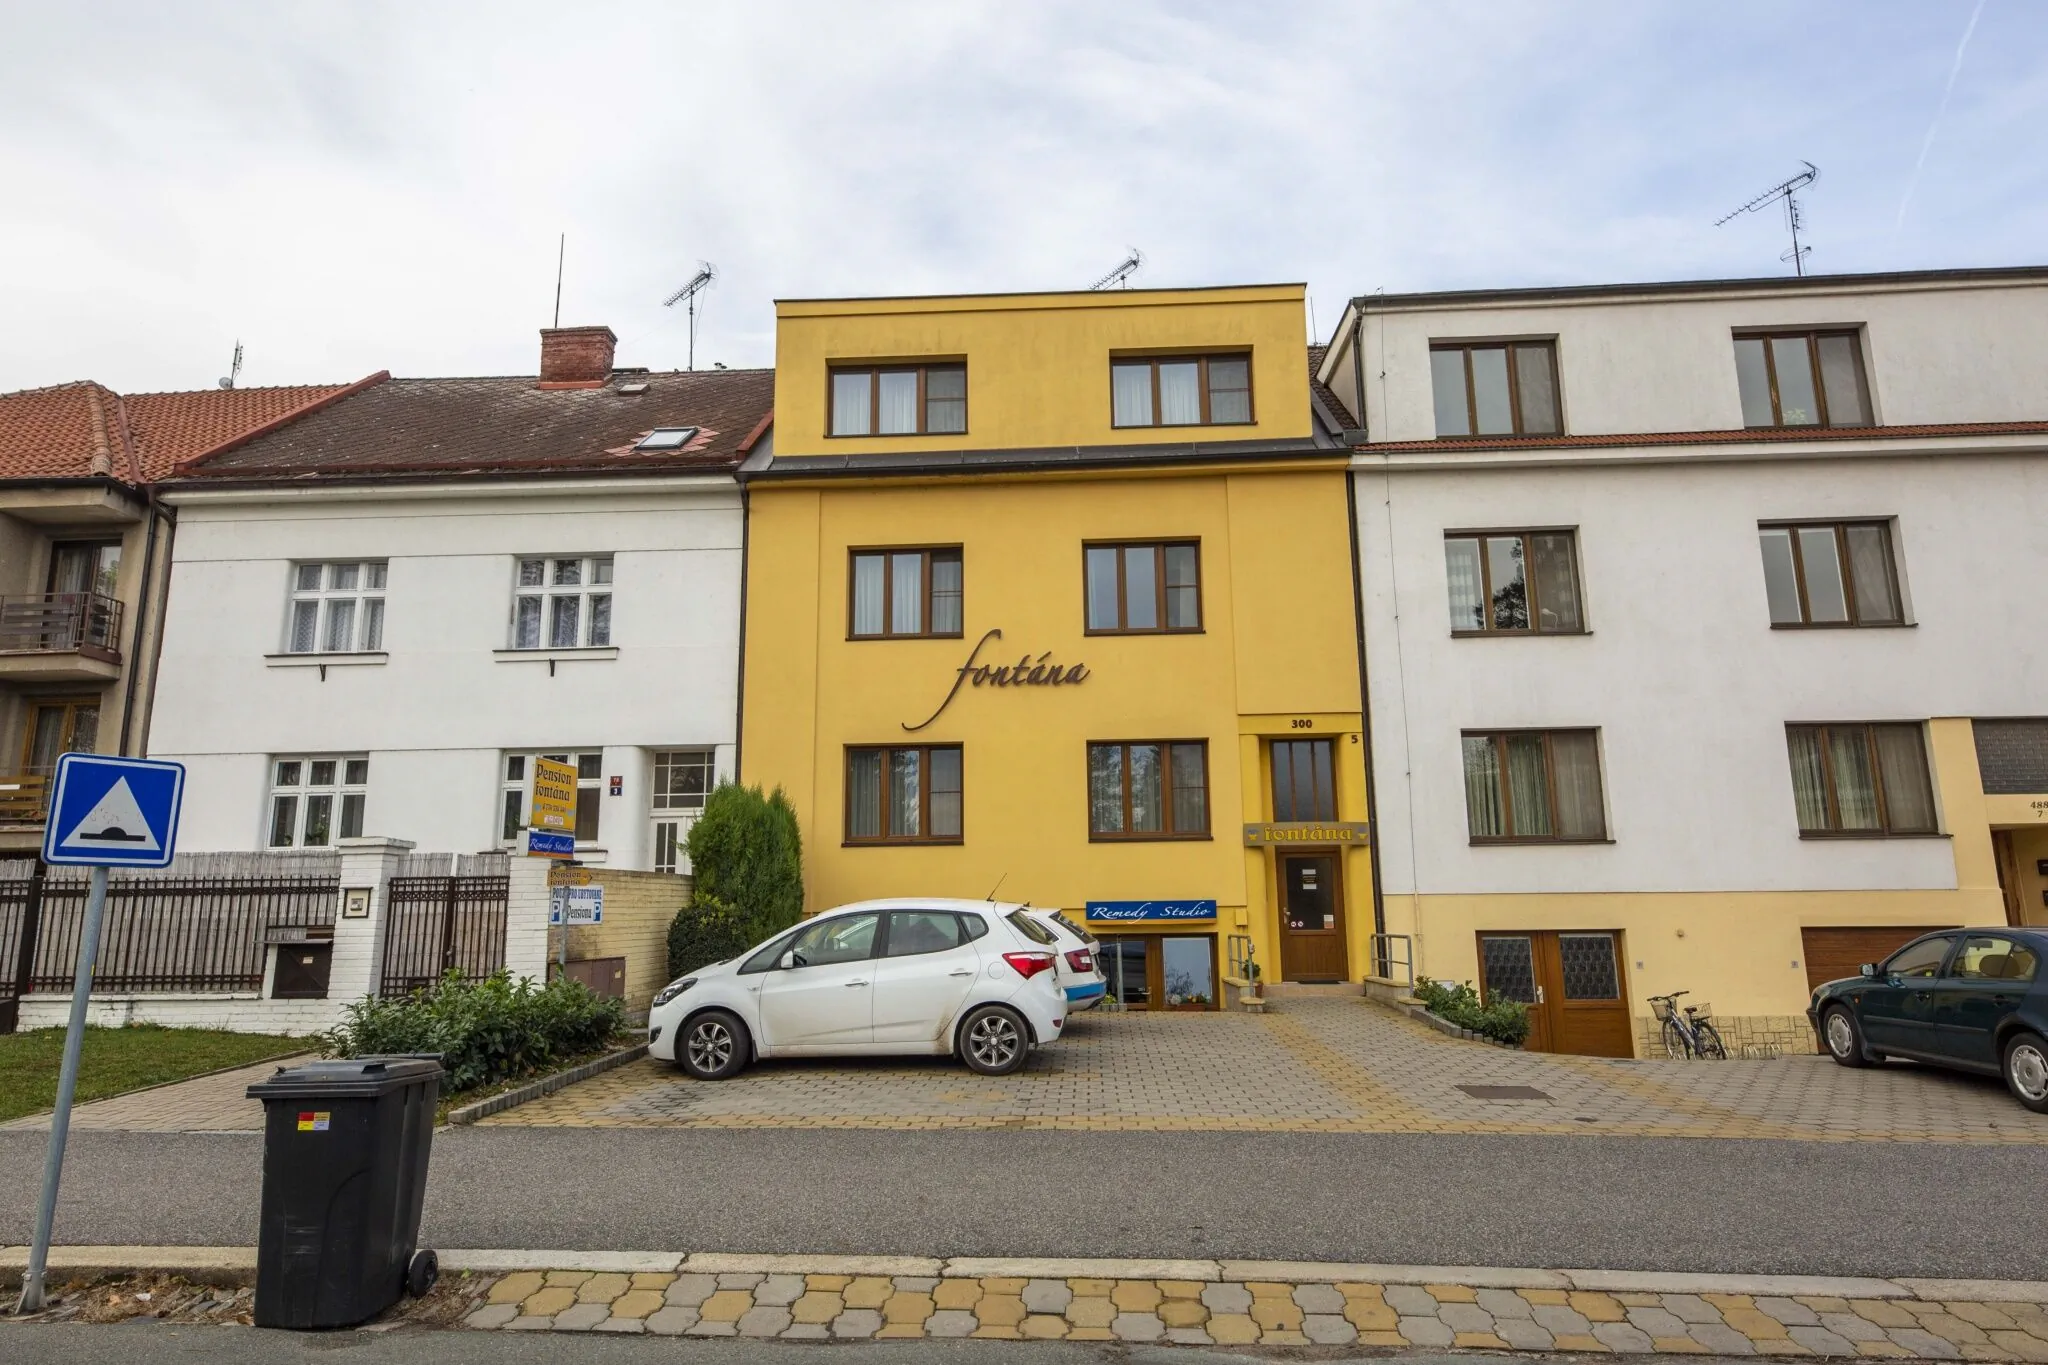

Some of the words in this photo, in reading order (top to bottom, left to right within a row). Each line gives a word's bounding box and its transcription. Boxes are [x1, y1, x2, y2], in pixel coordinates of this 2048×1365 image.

[901, 628, 1091, 732] fontána
[1291, 719, 1313, 729] 300
[1351, 735, 1358, 744] 5
[536, 763, 572, 786] Pension
[2030, 801, 2048, 809] 488
[2037, 810, 2043, 818] 7
[1264, 824, 1353, 841] fontána
[530, 836, 554, 855] Remedy
[553, 839, 573, 852] Studio
[1092, 902, 1152, 924] Remedy
[1159, 901, 1211, 917] Studio
